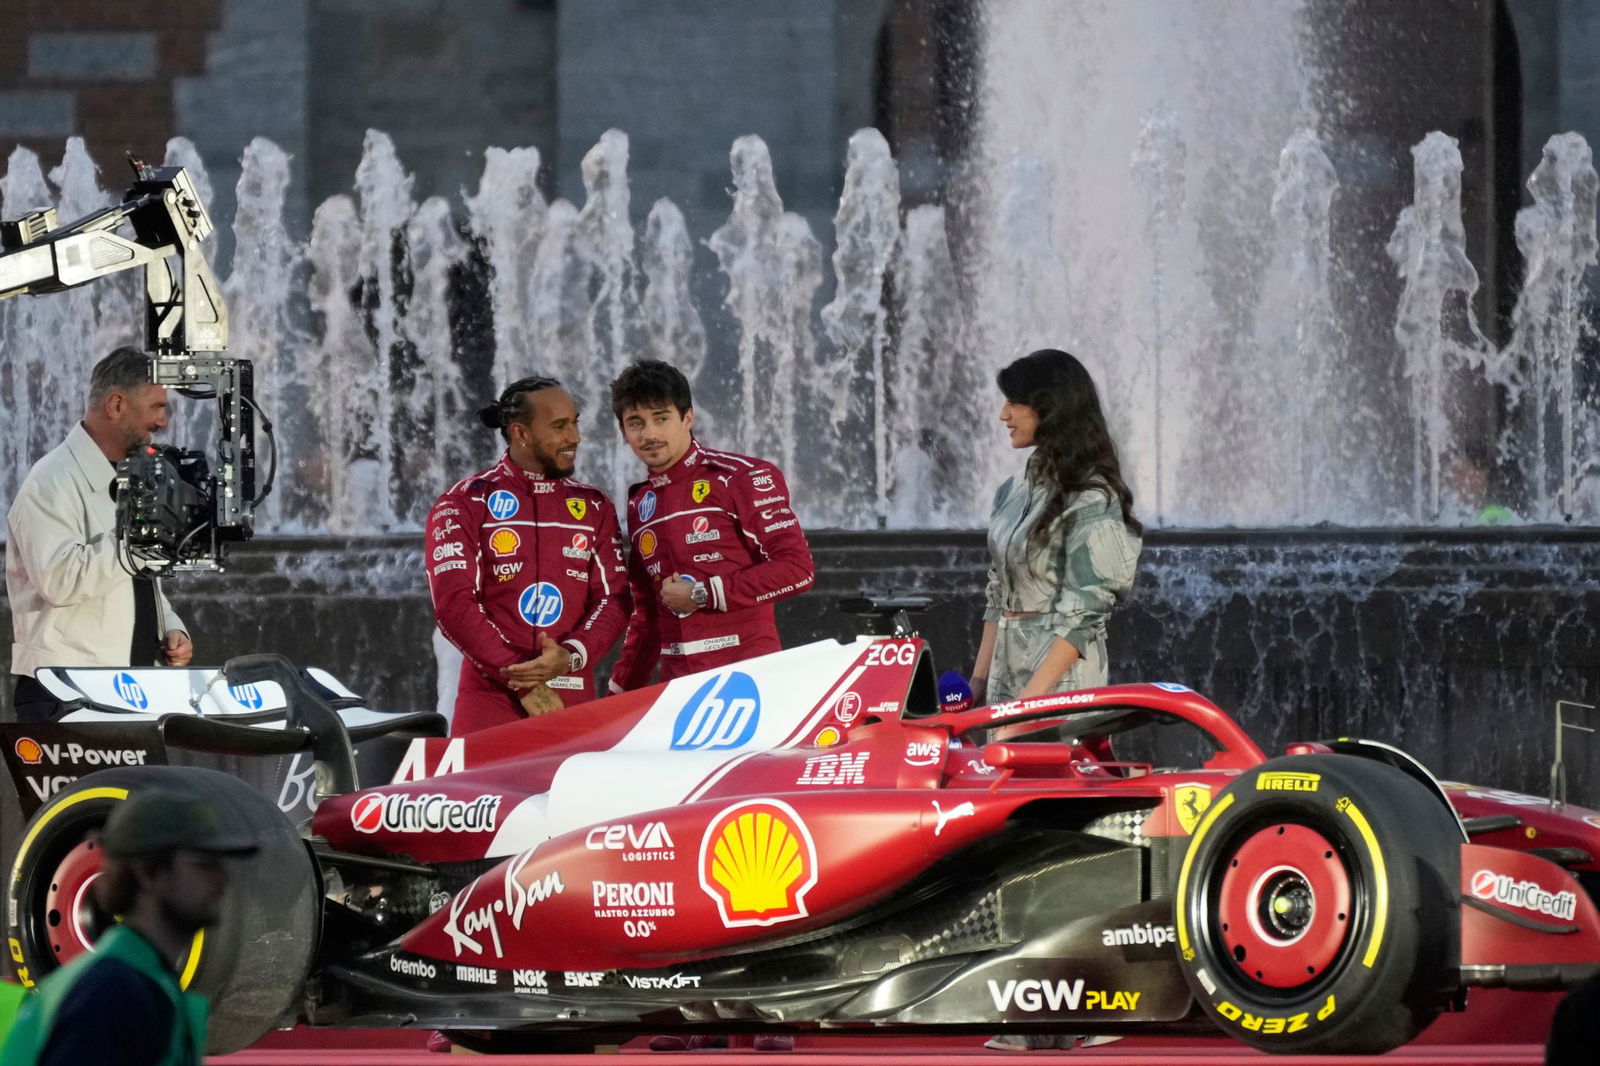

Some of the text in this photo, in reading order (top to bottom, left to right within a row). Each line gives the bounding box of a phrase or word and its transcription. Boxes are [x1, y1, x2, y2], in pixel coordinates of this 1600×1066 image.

[534, 482, 555, 493] IBM
[752, 475, 773, 486] aws
[493, 490, 515, 519] hp
[492, 562, 523, 576] VGW
[498, 574, 516, 582] PLAY
[756, 574, 814, 602] RICHARD MILL
[523, 583, 560, 627] hp
[703, 635, 737, 645] CHARLES
[703, 641, 736, 651] LECLERC
[864, 643, 916, 666] ZCG
[119, 672, 147, 709] hp
[945, 692, 962, 702] sky
[1023, 693, 1095, 710] TECHNOLOGY
[674, 671, 757, 750] hp
[945, 702, 968, 712] sport
[41, 743, 147, 766] V-Power
[906, 742, 941, 757] aws
[796, 752, 870, 785] IBM
[27, 775, 79, 802] VG
[1256, 771, 1321, 792] PIRELLI
[384, 794, 503, 832] UniCredit
[622, 851, 675, 862] LOGISTICS
[592, 880, 675, 907] PERONI
[1496, 875, 1576, 920] UniCredit
[594, 908, 675, 918] NASTRO AZZURRO
[1102, 922, 1177, 948] ambipa
[390, 954, 436, 979] brembo
[456, 965, 498, 984] MAHLE
[512, 969, 548, 987] NGK
[564, 971, 605, 987] SKF
[987, 978, 1141, 1013] VGW PLAY
[1216, 994, 1336, 1034] P ZERO
